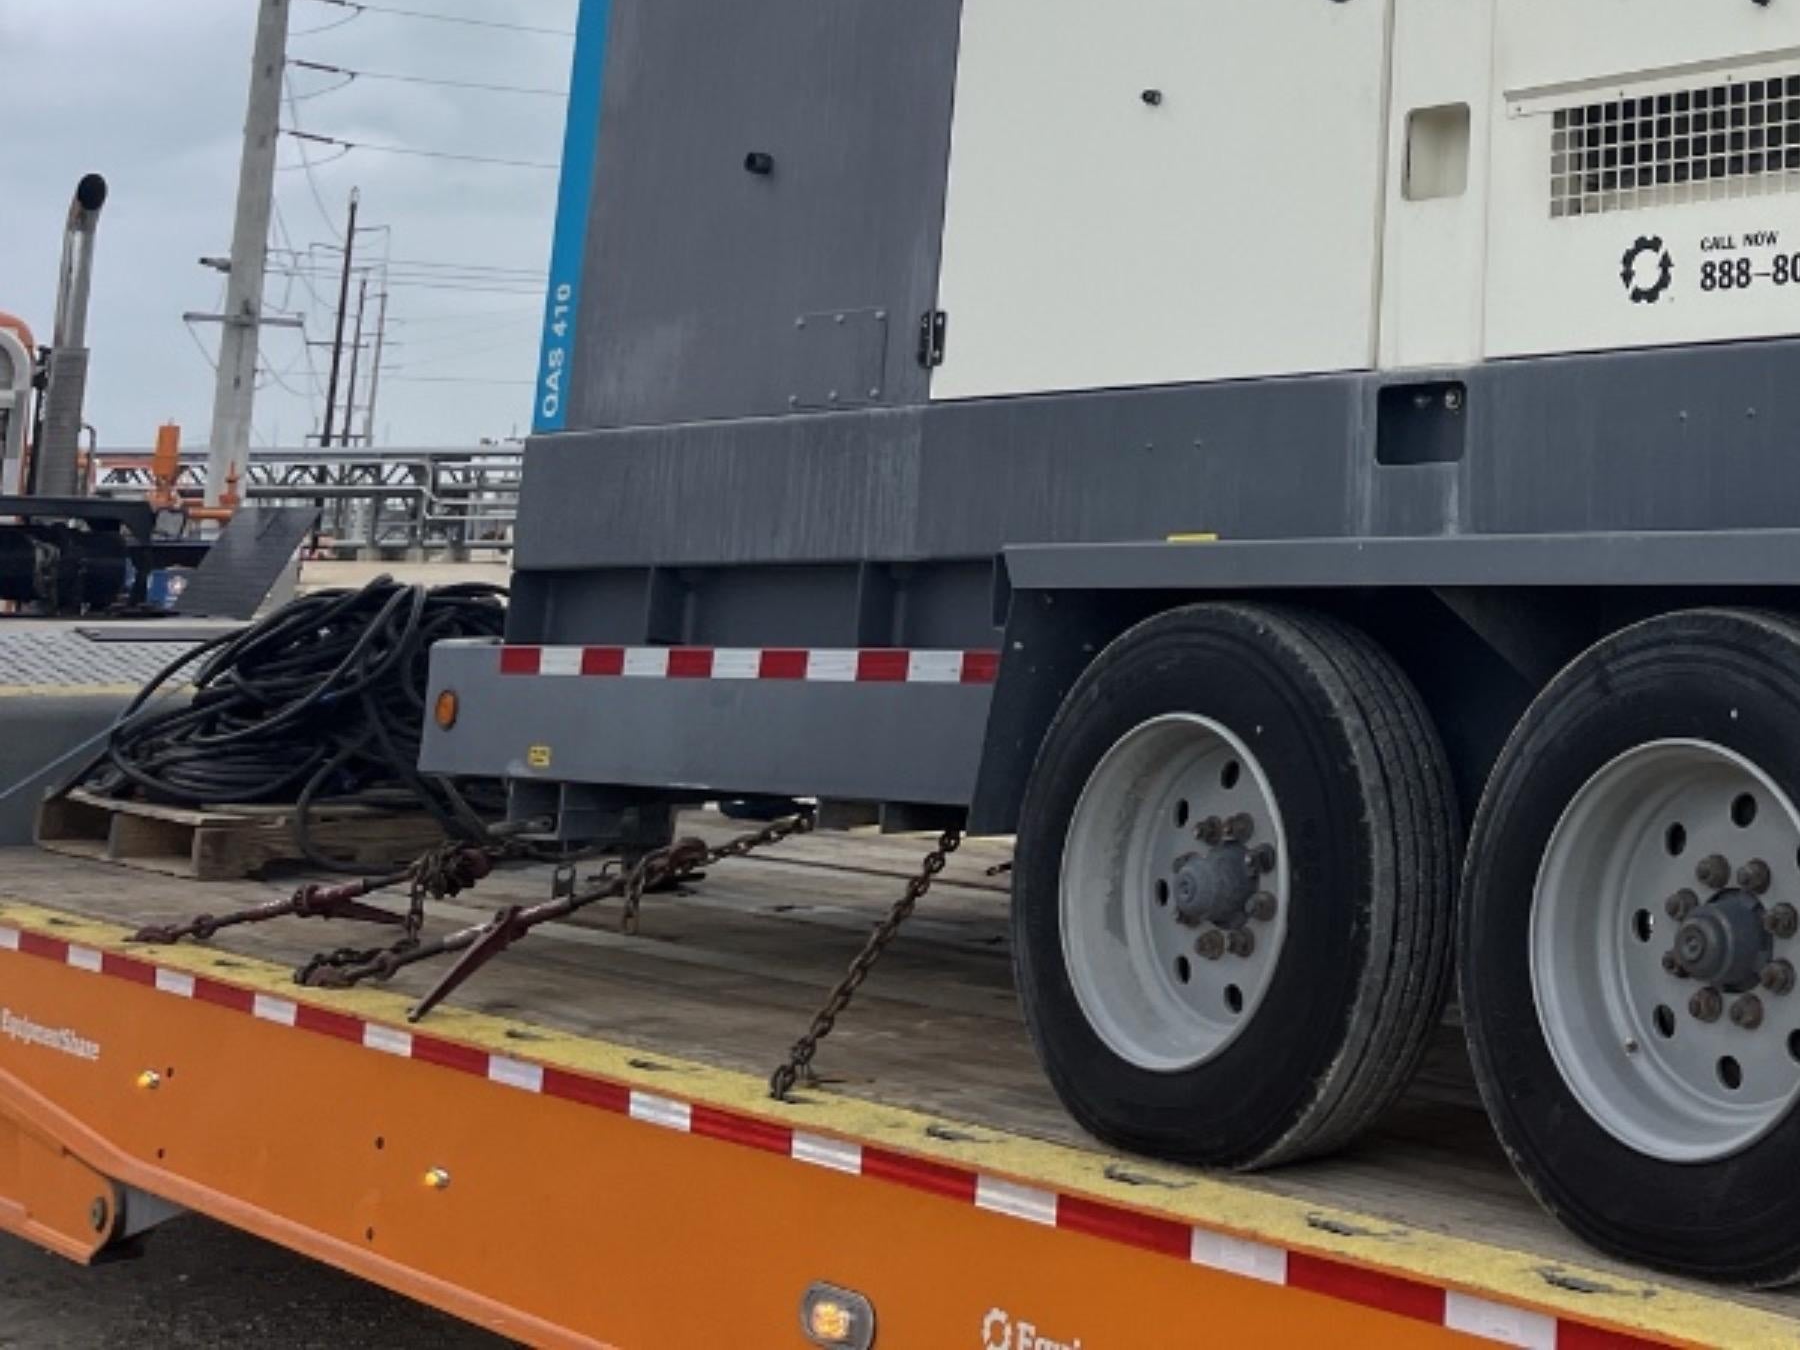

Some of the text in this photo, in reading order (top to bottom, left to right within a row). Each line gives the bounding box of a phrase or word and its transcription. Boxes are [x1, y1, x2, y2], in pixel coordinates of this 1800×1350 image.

[1700, 231, 1780, 252] CALL NOW
[551, 283, 572, 337] 410
[2, 1006, 101, 1063] EquipmentShare
